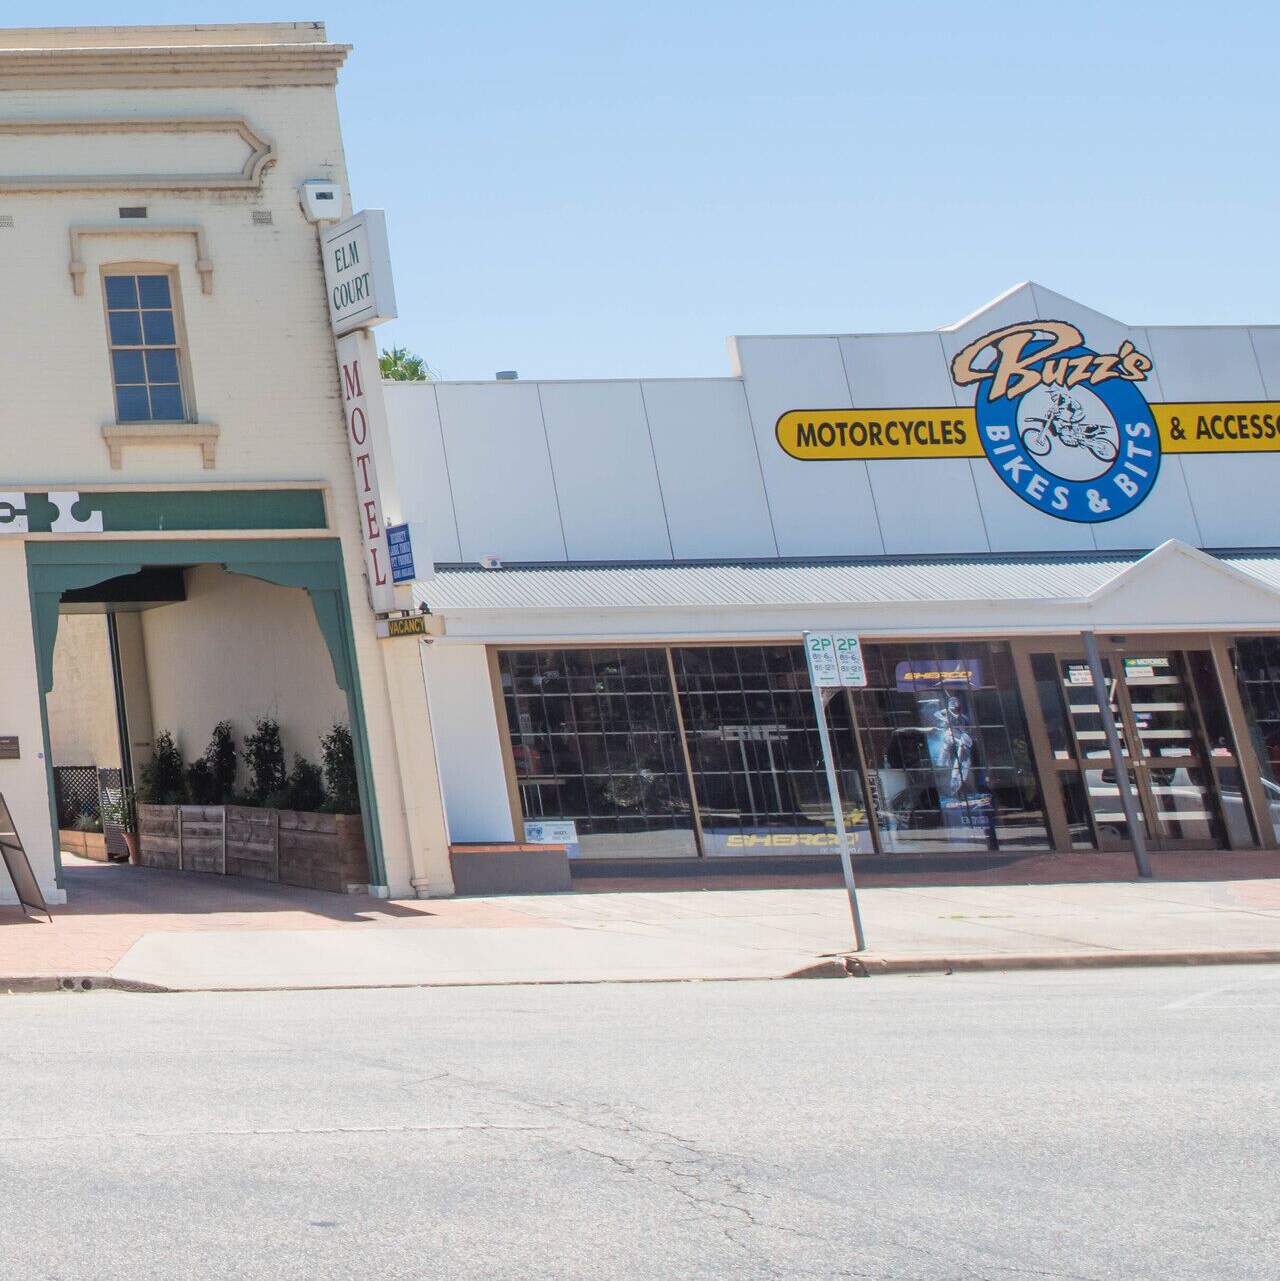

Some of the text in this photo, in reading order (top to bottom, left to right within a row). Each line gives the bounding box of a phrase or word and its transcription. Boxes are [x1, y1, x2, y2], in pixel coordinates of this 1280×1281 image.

[334, 240, 360, 273] ELM
[333, 272, 371, 311] COURT
[950, 319, 1153, 401] Buzz's
[796, 413, 1280, 448] MOTORCYCLES & ACCESS
[343, 359, 387, 587] MOTEL
[985, 421, 1153, 514] BIKES & BITS
[389, 618, 425, 635] VACANCY
[810, 638, 832, 651] 2P
[836, 638, 858, 651] 2P
